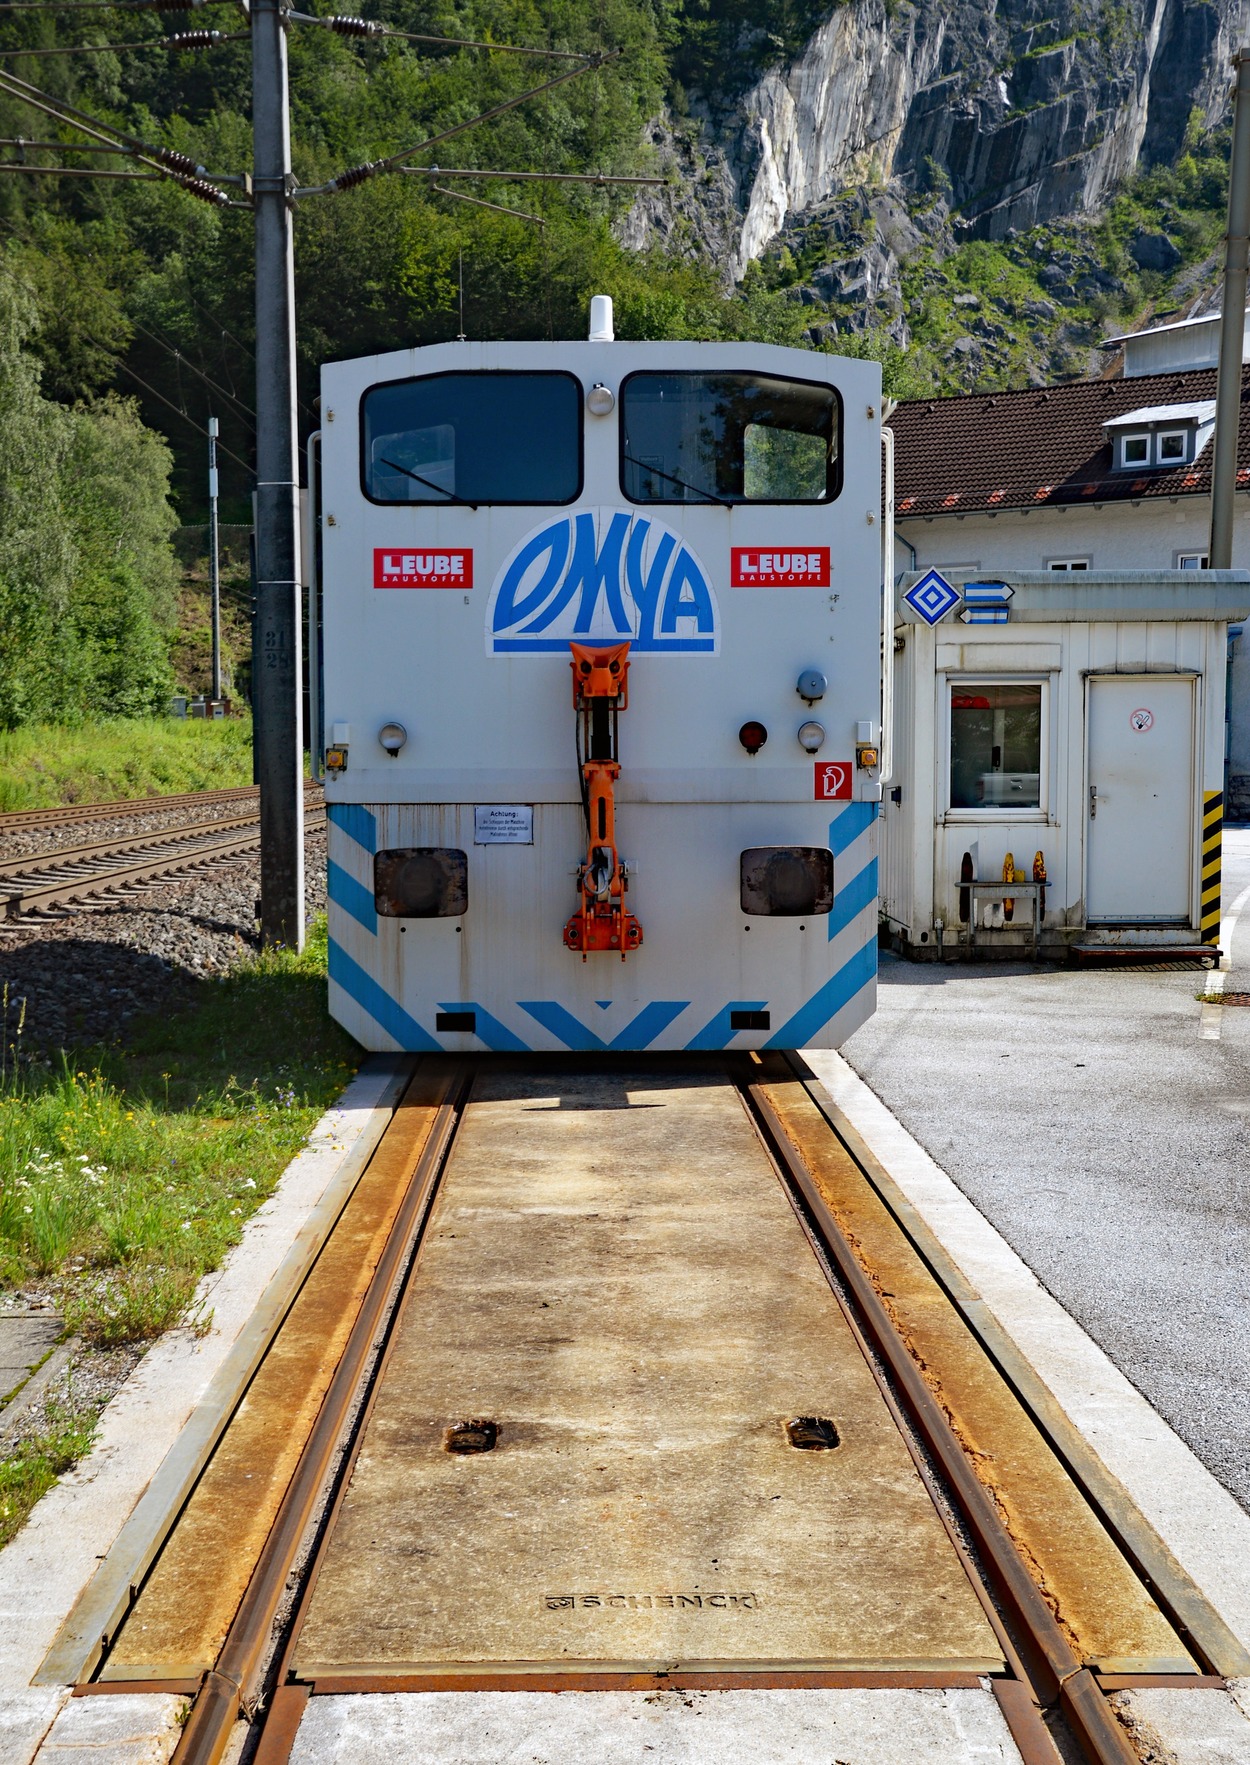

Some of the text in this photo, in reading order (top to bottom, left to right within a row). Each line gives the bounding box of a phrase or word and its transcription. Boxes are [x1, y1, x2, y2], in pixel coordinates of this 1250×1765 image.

[382, 554, 465, 575] LEUBE
[739, 553, 822, 574] LEUBE
[382, 575, 465, 583] BAUSTOFFE
[492, 512, 715, 648] OMYA
[739, 574, 822, 582] BAUSTOFFE
[579, 1594, 754, 1609] SCHENCK
